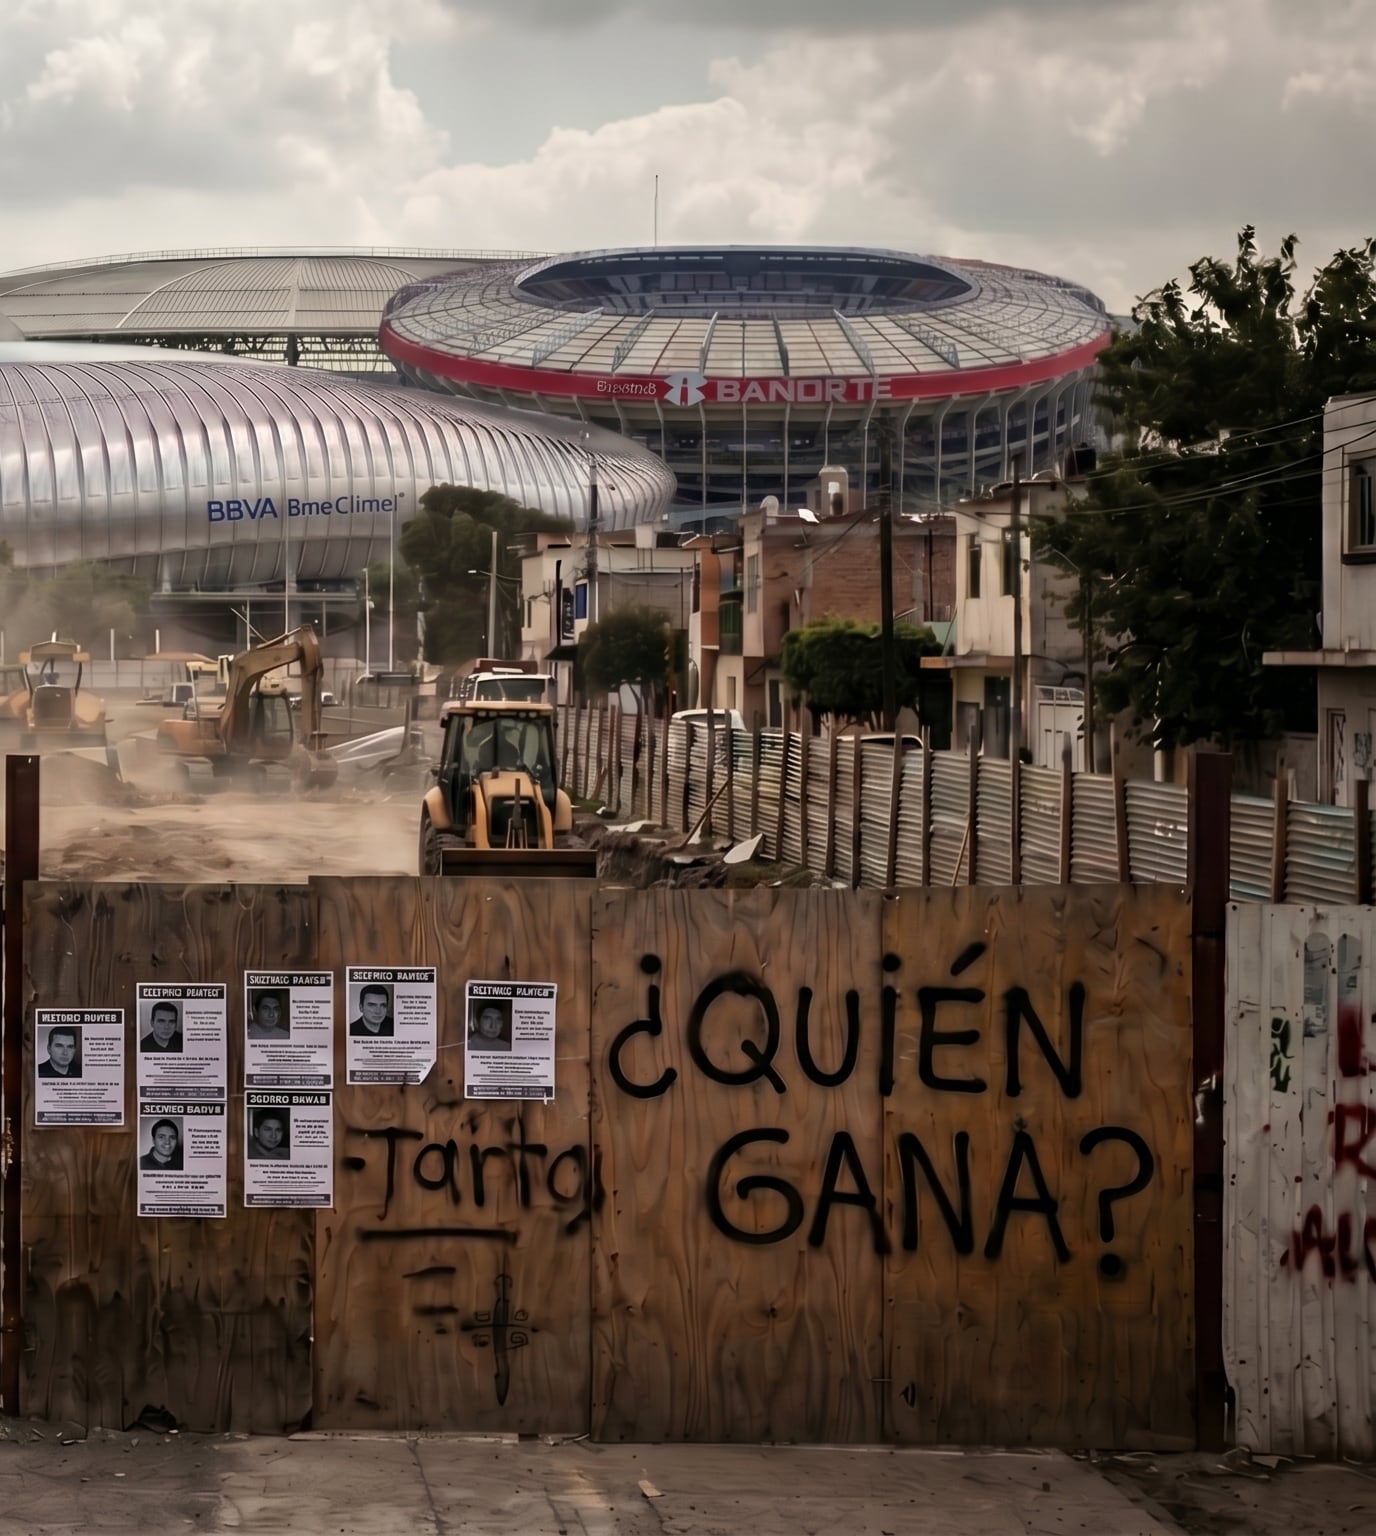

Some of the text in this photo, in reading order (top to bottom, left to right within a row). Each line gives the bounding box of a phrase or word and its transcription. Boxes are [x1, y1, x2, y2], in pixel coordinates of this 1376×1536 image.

[716, 375, 893, 402] BANORTE
[207, 497, 278, 522] BBVA
[608, 942, 1086, 1099] ¿QUIÉN
[707, 1127, 1154, 1276] GANA?
